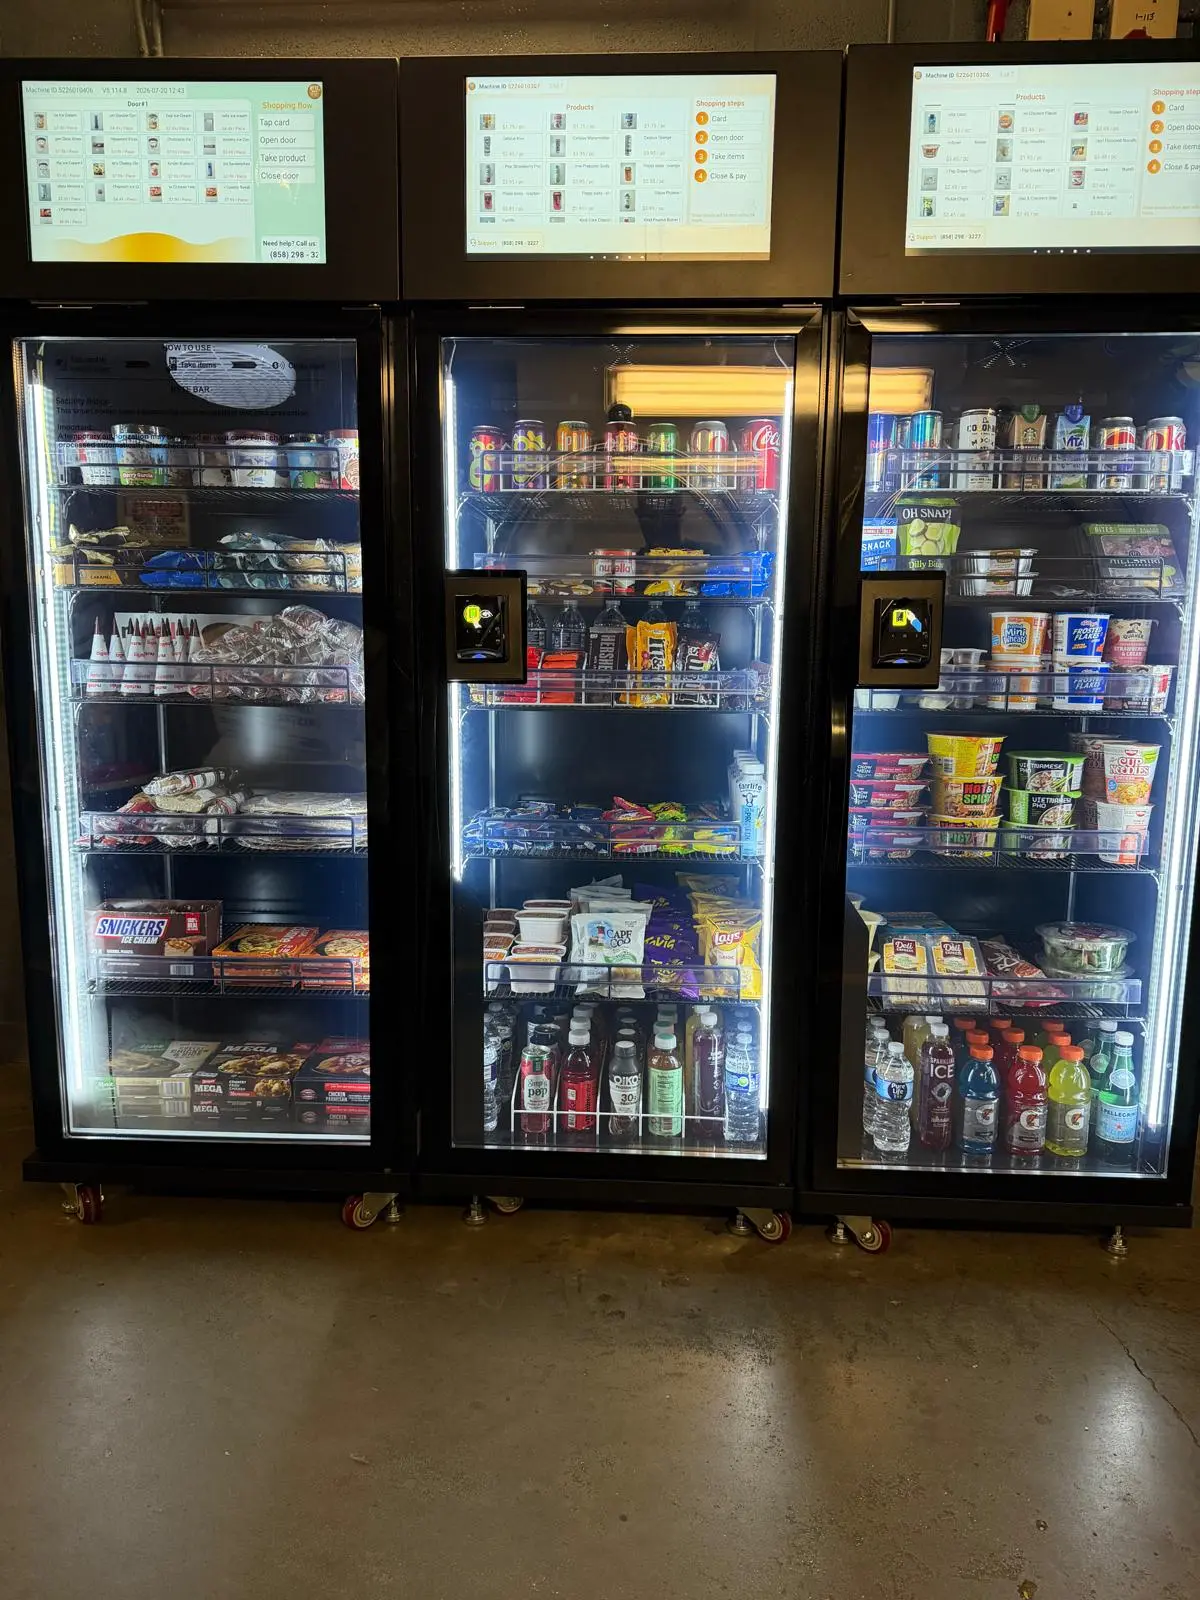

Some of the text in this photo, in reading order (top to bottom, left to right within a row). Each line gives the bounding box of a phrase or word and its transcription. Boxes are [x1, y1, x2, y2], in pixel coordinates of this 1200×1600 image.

[25, 86, 50, 94] Machine
[262, 102, 296, 110] Shopping
[696, 100, 726, 108] Shopping
[260, 119, 273, 127] Tap
[260, 136, 297, 145] Open door
[261, 154, 306, 163] Take product
[1164, 163, 1183, 171] Close
[261, 172, 299, 180] Close door
[710, 172, 728, 180] Close
[735, 173, 747, 181] pay
[270, 251, 289, 259] (858)
[182, 344, 193, 352] TO
[193, 385, 210, 393] BAR
[1063, 436, 1085, 447] VITA
[902, 508, 952, 520] OH SNAP!
[862, 540, 891, 552] SNACK
[599, 561, 632, 573] nuella
[908, 560, 926, 569] Dilly
[1005, 628, 1027, 636] Mini
[1072, 626, 1103, 636] FROSTED
[1074, 633, 1100, 642] FLAKES
[1119, 757, 1143, 767] CUP
[1110, 765, 1149, 776] NOODLES
[738, 782, 763, 791] fairlife
[963, 794, 991, 805] SPICY
[98, 918, 165, 937] SNICKERS
[121, 936, 159, 945] ICE CREAM
[894, 941, 914, 950] Deli
[942, 944, 962, 952] Deli
[930, 1064, 954, 1079] ICE
[194, 1084, 224, 1094] MEGA
[891, 1082, 906, 1090] Pure
[892, 1088, 904, 1096] Life
[193, 1105, 220, 1113] MEGA
